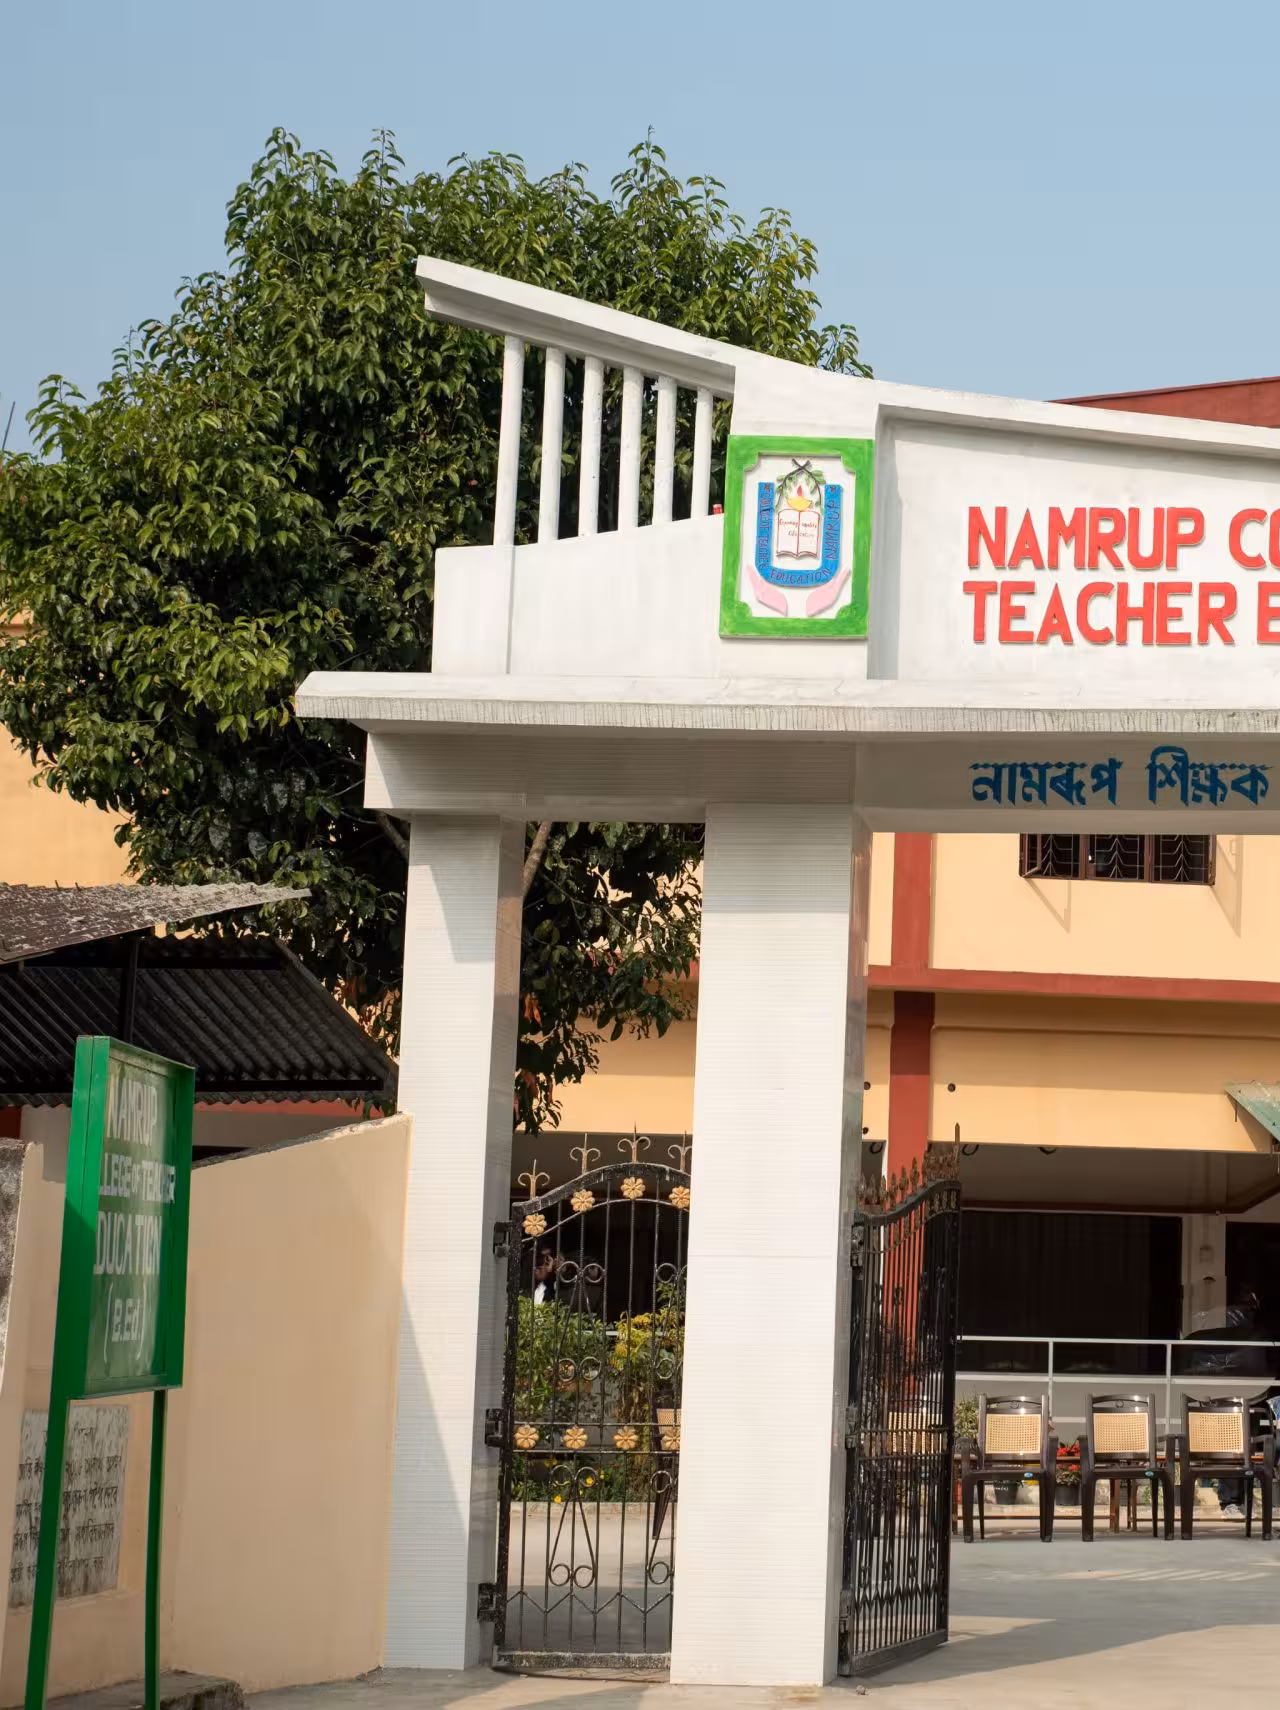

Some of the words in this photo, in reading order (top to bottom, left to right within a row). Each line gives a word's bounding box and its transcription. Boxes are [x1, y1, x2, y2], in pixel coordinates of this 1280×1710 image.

[771, 568, 830, 584] EDUCATION
[825, 500, 840, 561] NAMRUP
[967, 505, 1205, 569] NAMRUP
[962, 580, 1237, 645] TEACHER
[1145, 745, 1275, 806] শিক্ষক
[107, 1073, 158, 1146] NAMRUP
[99, 1151, 133, 1198] LEGE
[93, 1210, 163, 1275] DUCATION
